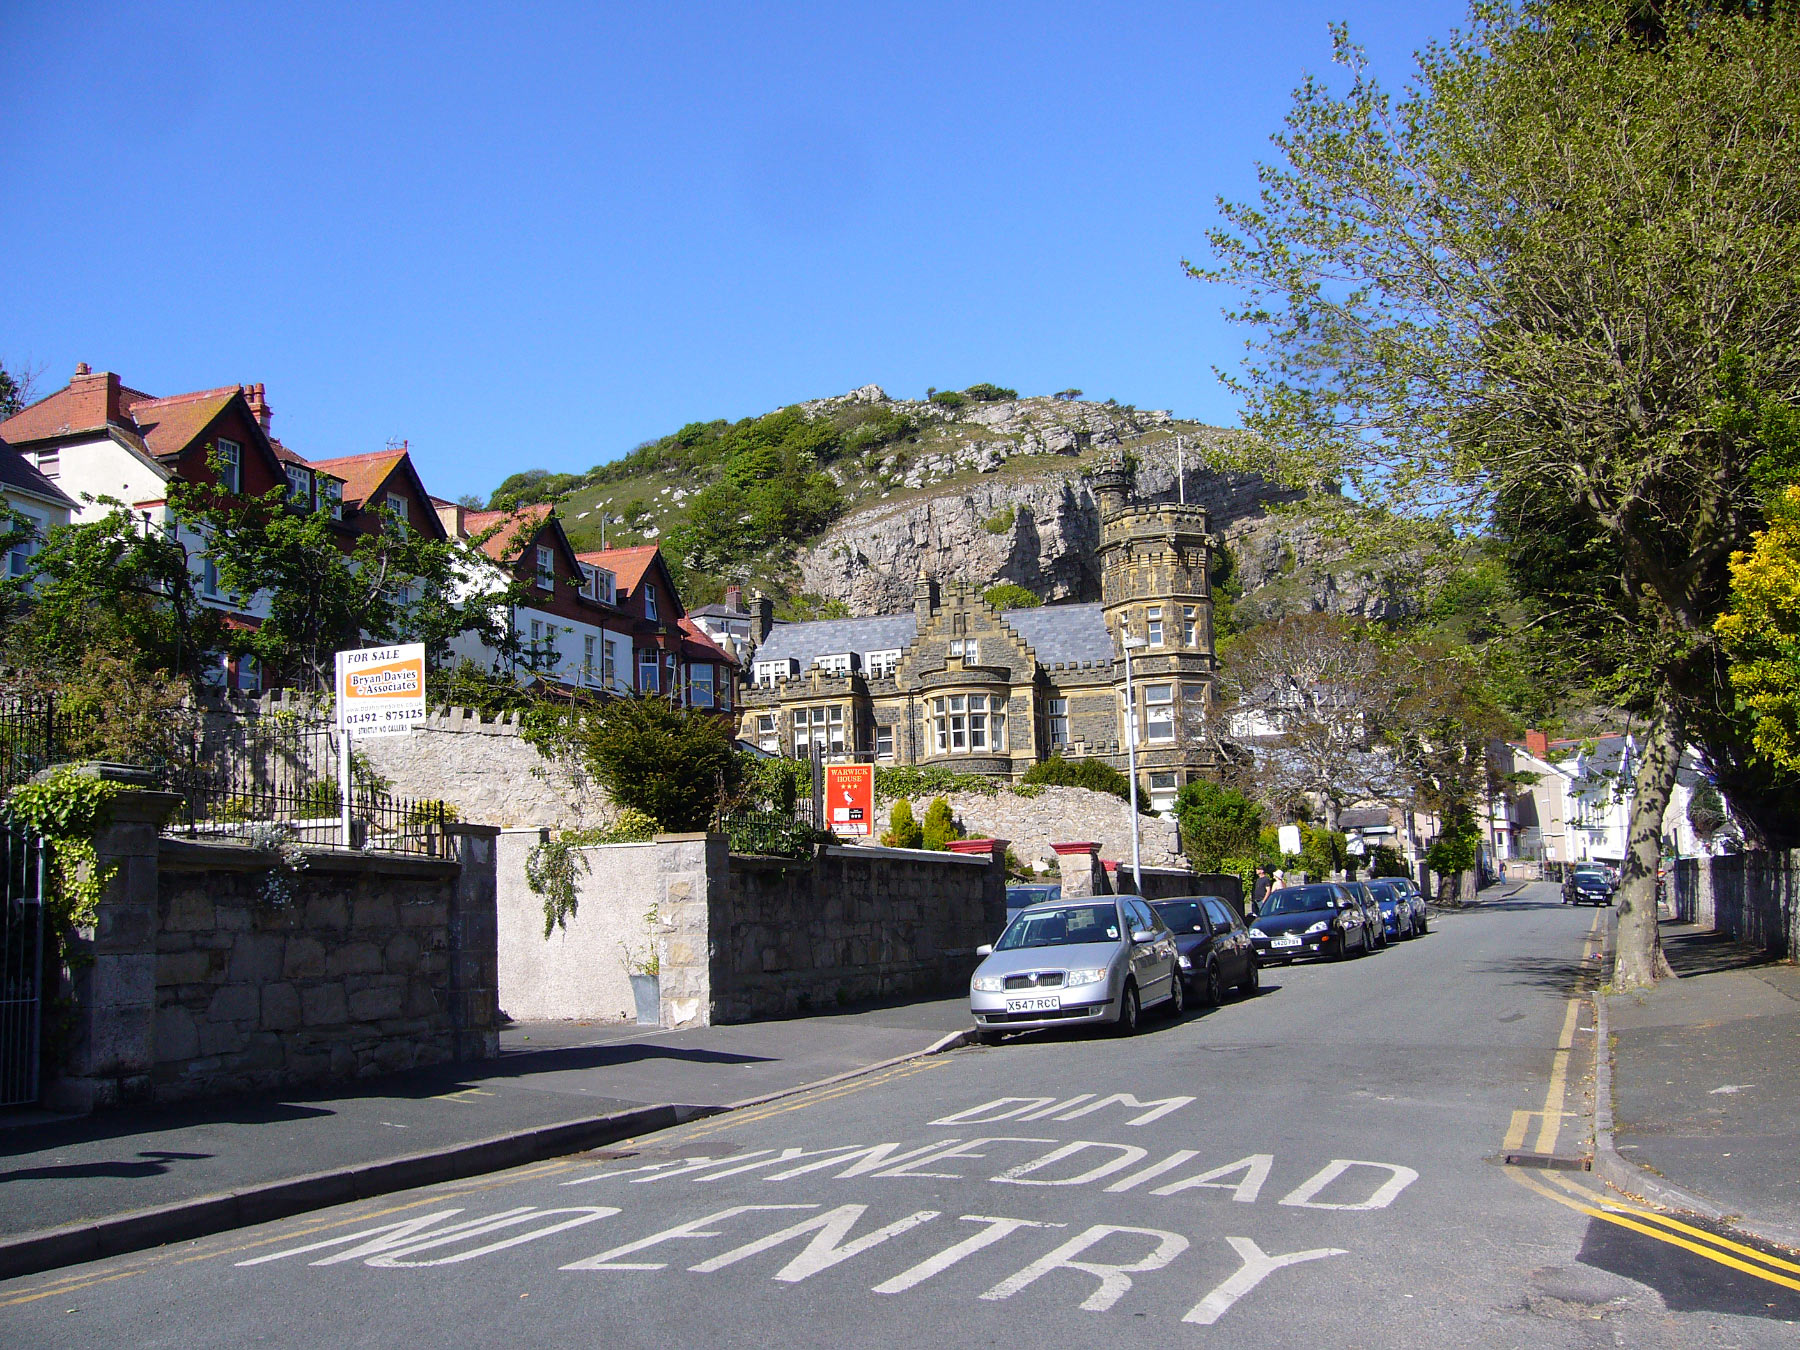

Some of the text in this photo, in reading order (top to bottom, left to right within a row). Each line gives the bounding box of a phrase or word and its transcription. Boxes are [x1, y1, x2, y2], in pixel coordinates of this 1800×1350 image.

[348, 650, 400, 663] FOR SALE
[353, 671, 416, 685] Bryan Davies
[367, 682, 416, 694] Associates
[347, 713, 377, 724] 01492
[386, 709, 423, 721] 875125
[379, 725, 387, 733] NO
[388, 724, 408, 733] CALLERS
[1008, 999, 1057, 1011] X547 RCC
[926, 1093, 1197, 1126] DIM
[558, 1137, 1419, 1211] MYNEDIAD
[235, 1203, 1349, 1325] NO ENTRY
